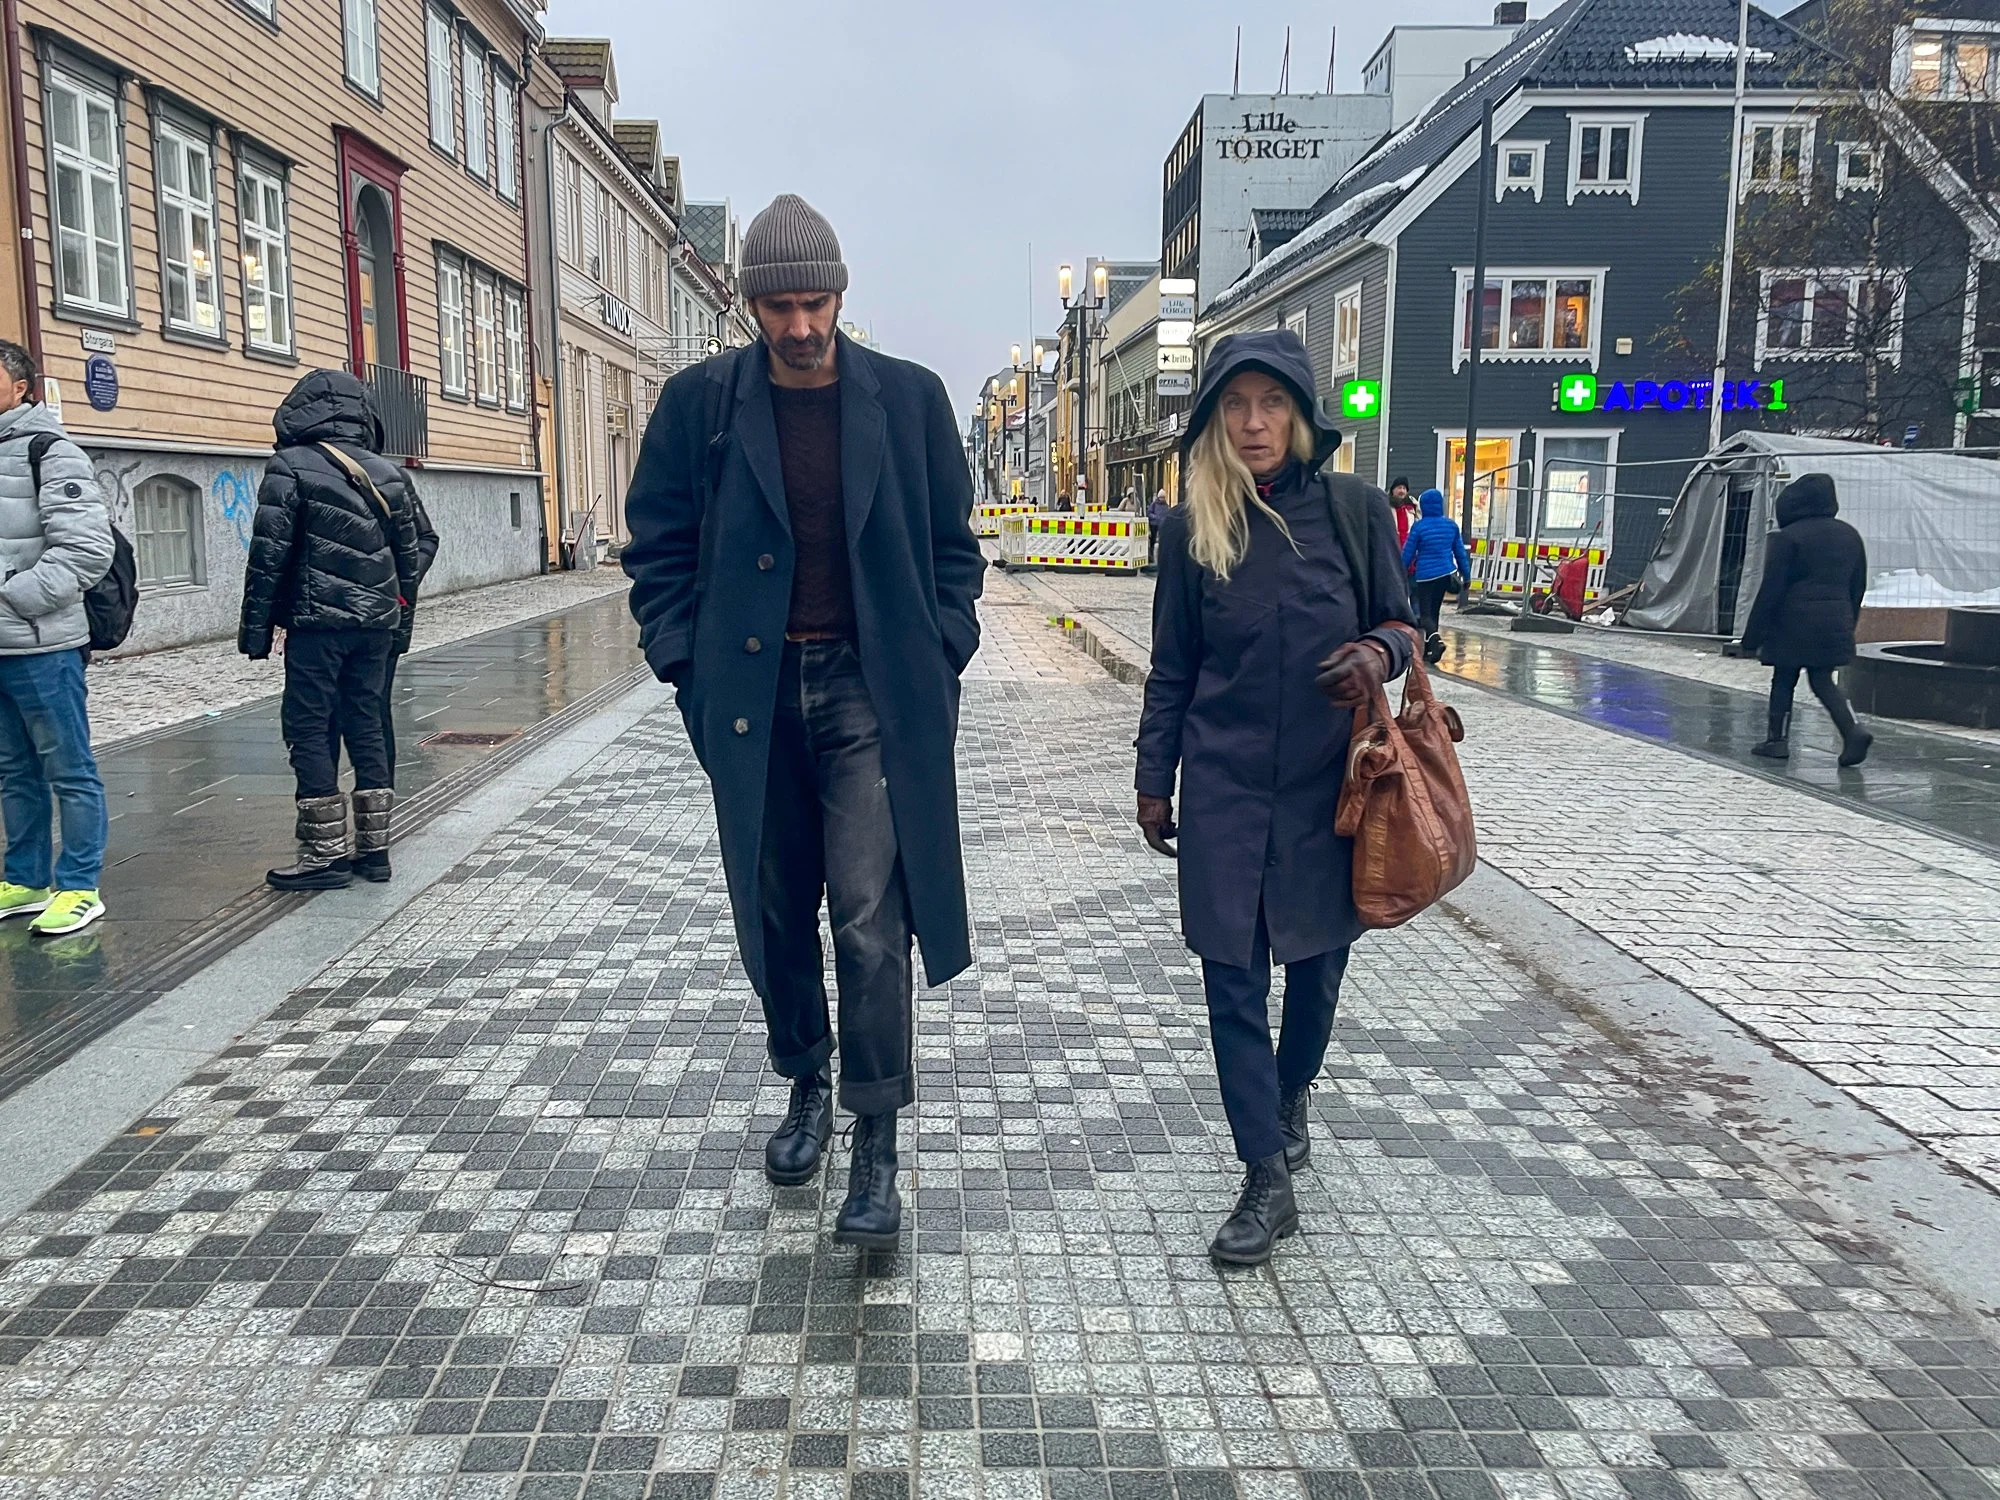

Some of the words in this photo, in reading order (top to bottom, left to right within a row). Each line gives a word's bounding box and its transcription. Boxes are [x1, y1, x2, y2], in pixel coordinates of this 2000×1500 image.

[1242, 112, 1297, 134] Lille
[1215, 138, 1325, 159] TORGET
[1162, 306, 1192, 314] TORGET
[1172, 354, 1191, 363] britts
[1602, 380, 1761, 411] APOTEK
[1767, 379, 1788, 410] 1
